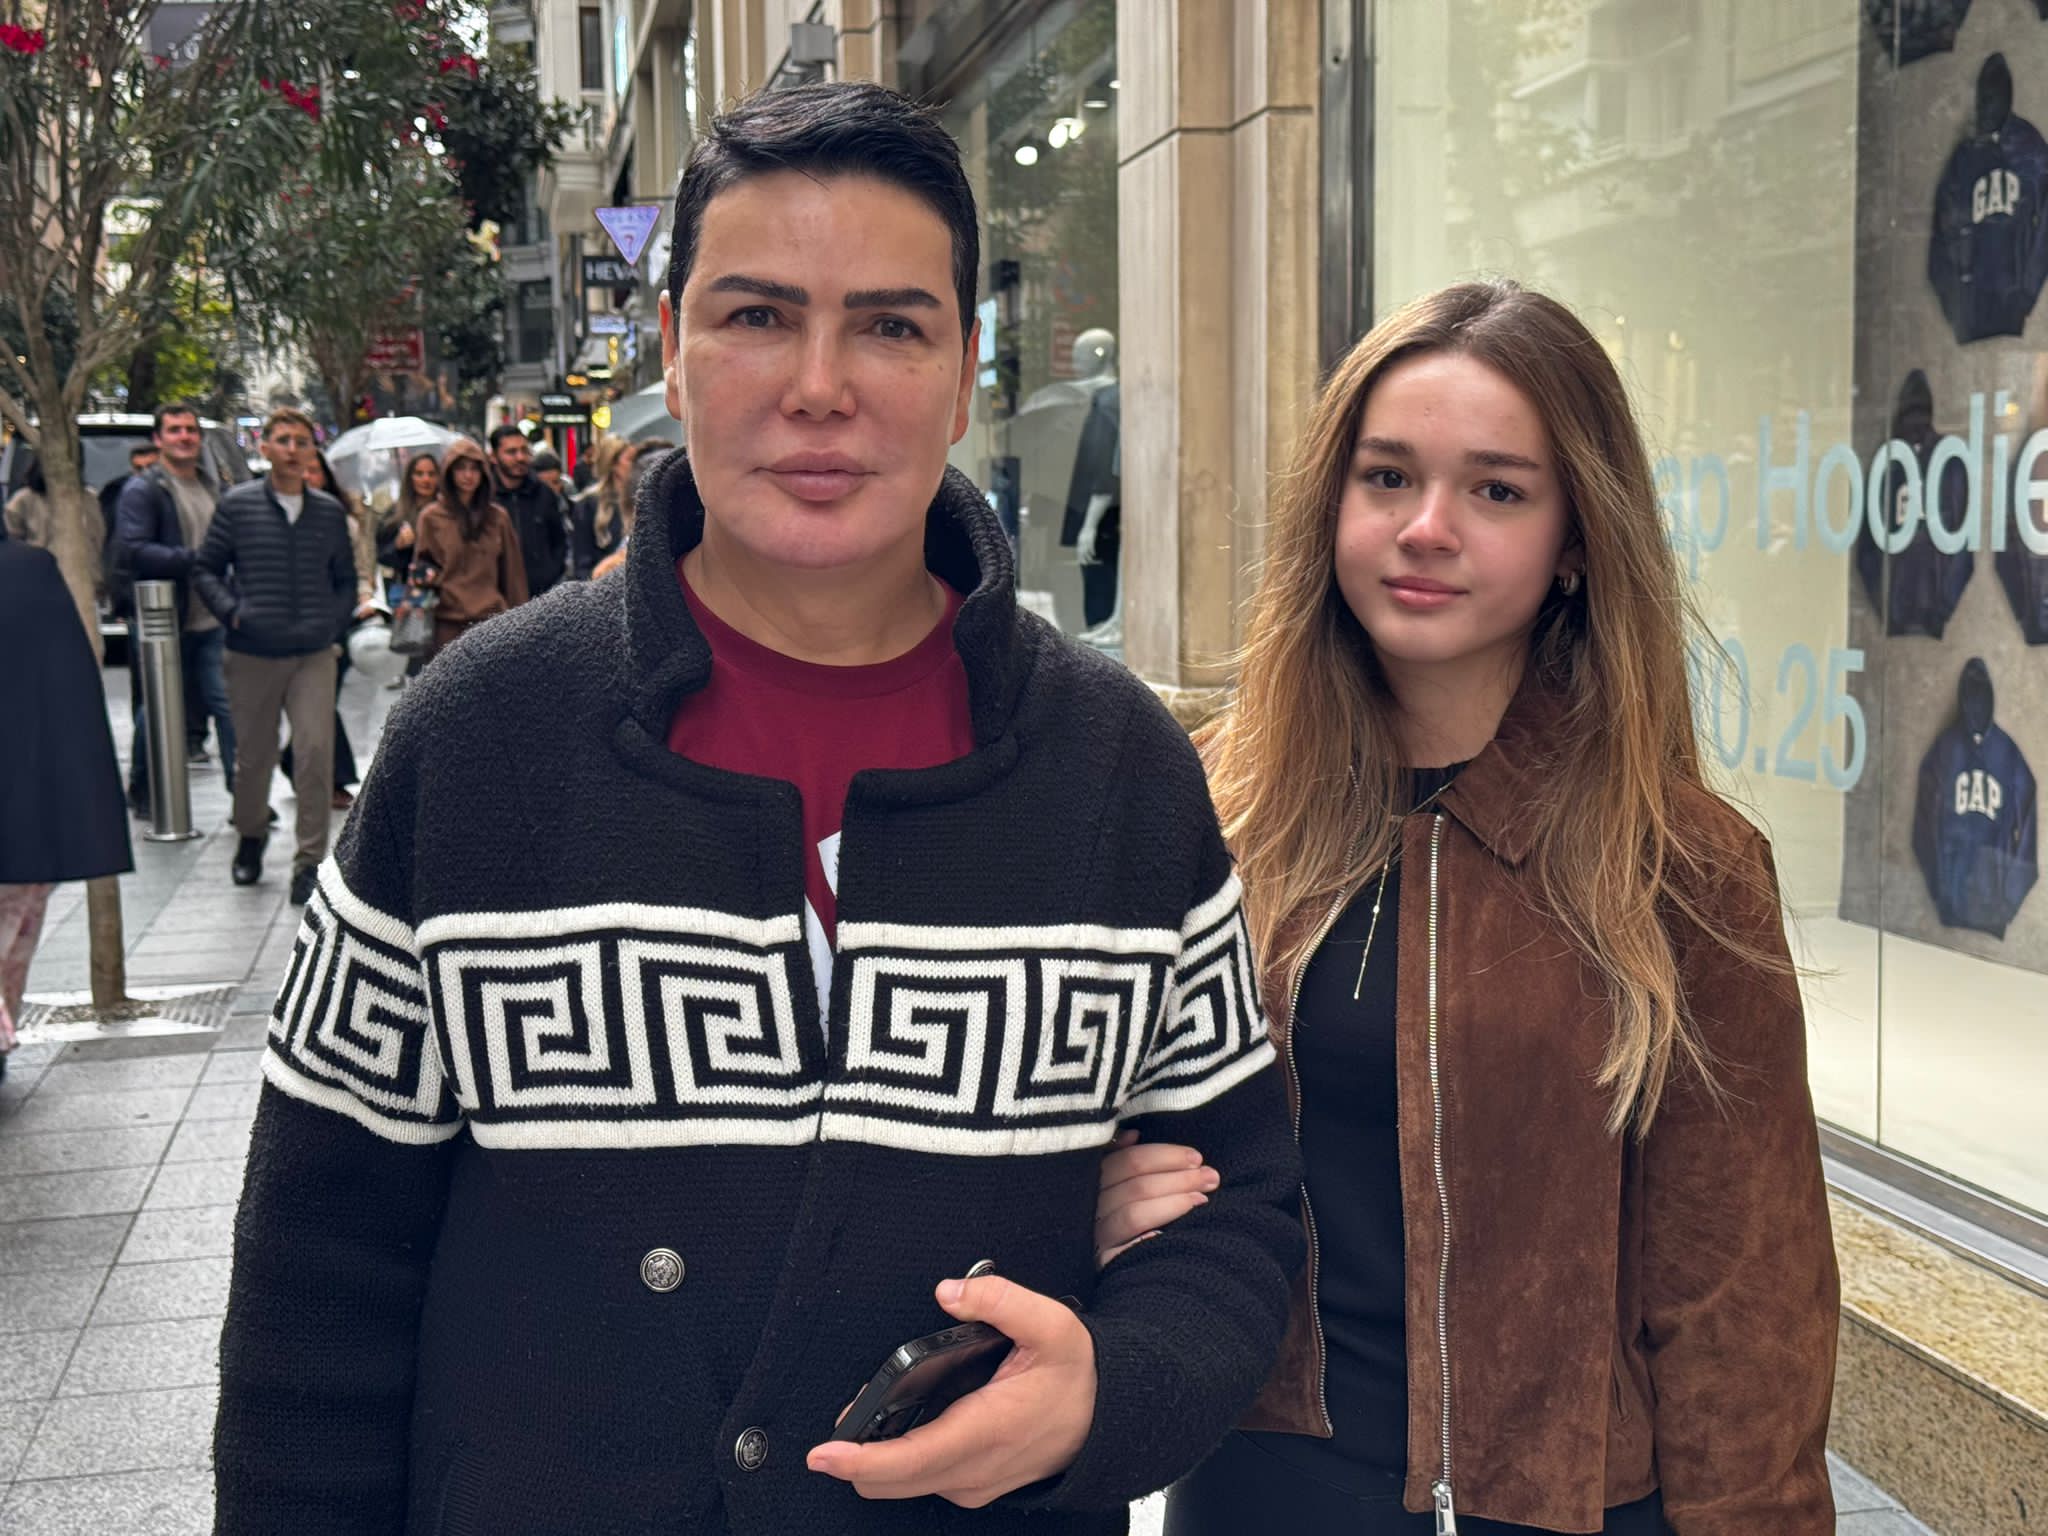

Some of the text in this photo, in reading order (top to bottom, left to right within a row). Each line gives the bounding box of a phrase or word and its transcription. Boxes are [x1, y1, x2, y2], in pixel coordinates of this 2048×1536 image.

[1972, 168, 2020, 224] GAP
[1653, 454, 1729, 583] ap
[1955, 769, 2002, 821] GAP
